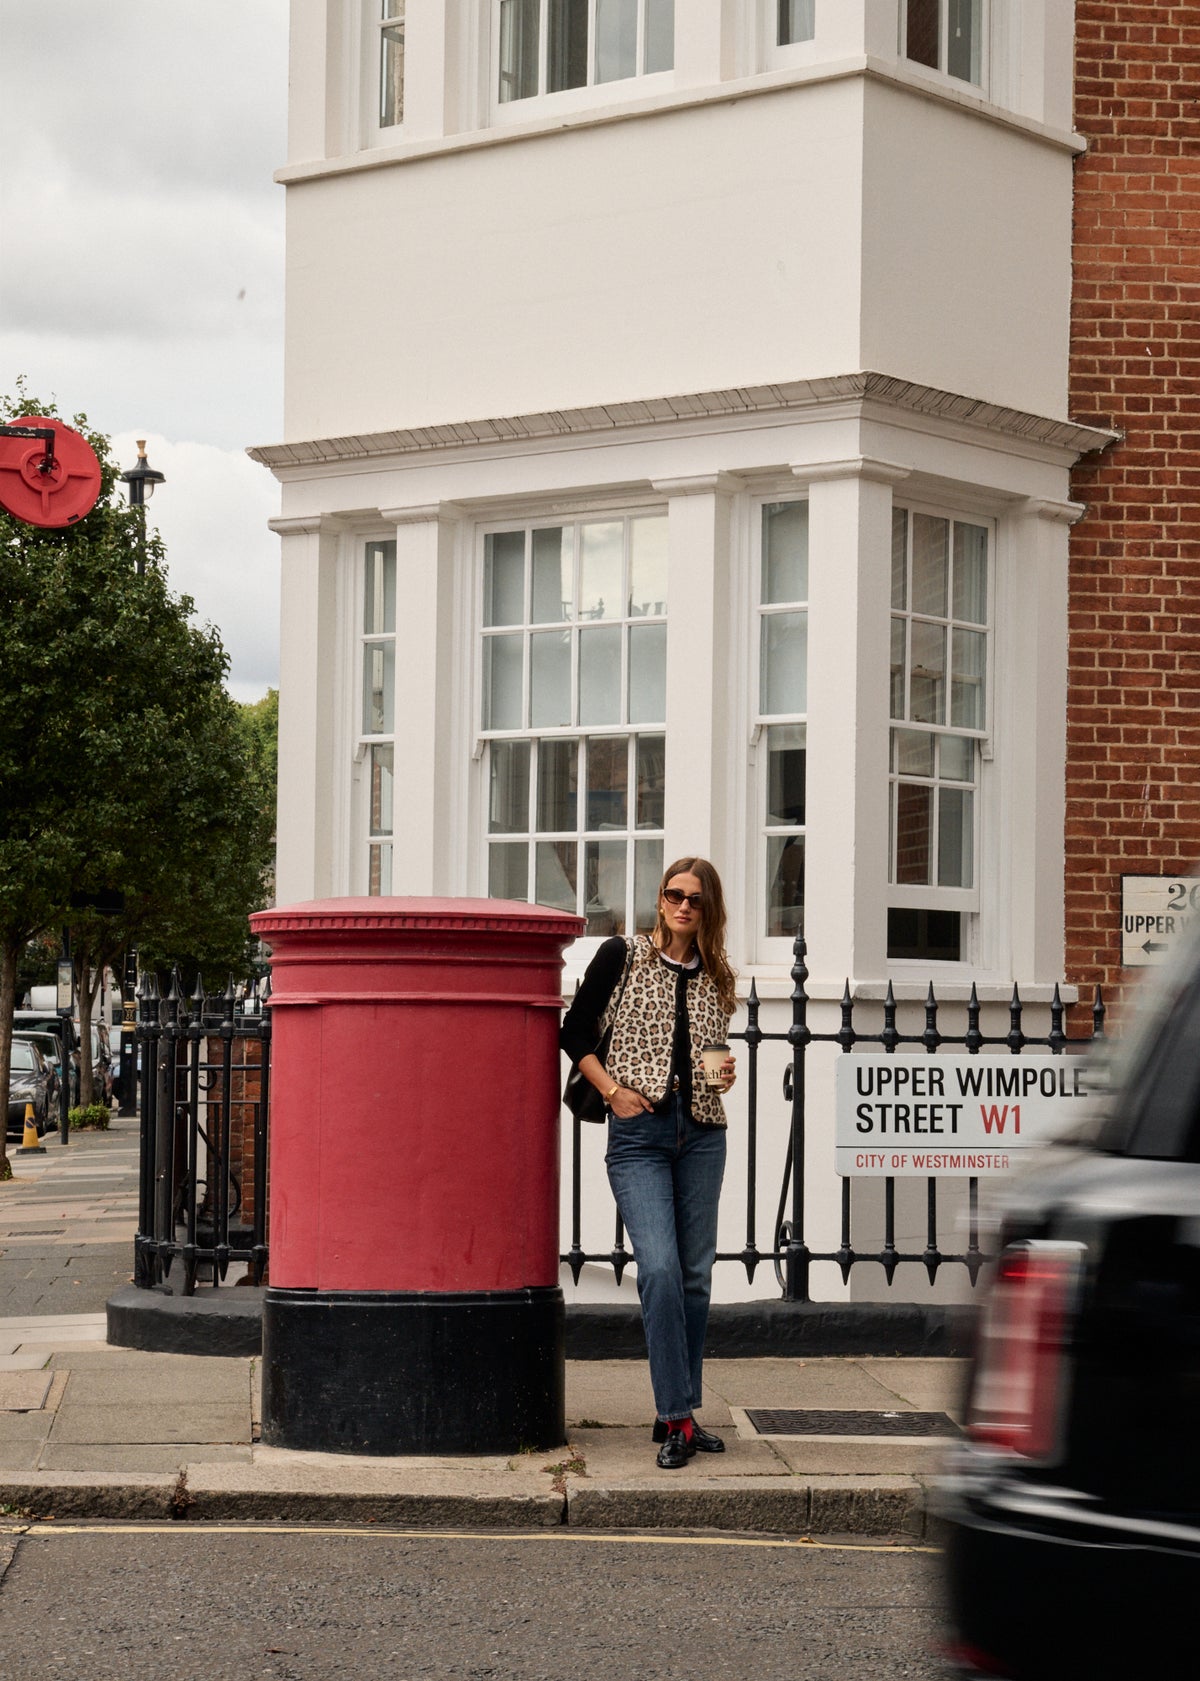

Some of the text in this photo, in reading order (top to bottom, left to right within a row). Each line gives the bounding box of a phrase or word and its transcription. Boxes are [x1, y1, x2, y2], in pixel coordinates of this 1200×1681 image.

[1125, 915, 1175, 934] UPPER
[856, 1066, 1088, 1098] UPPER WIMPOLE
[856, 1103, 1021, 1134] STREET W1
[856, 1154, 1009, 1169] CITY OF WESTMINSTER
